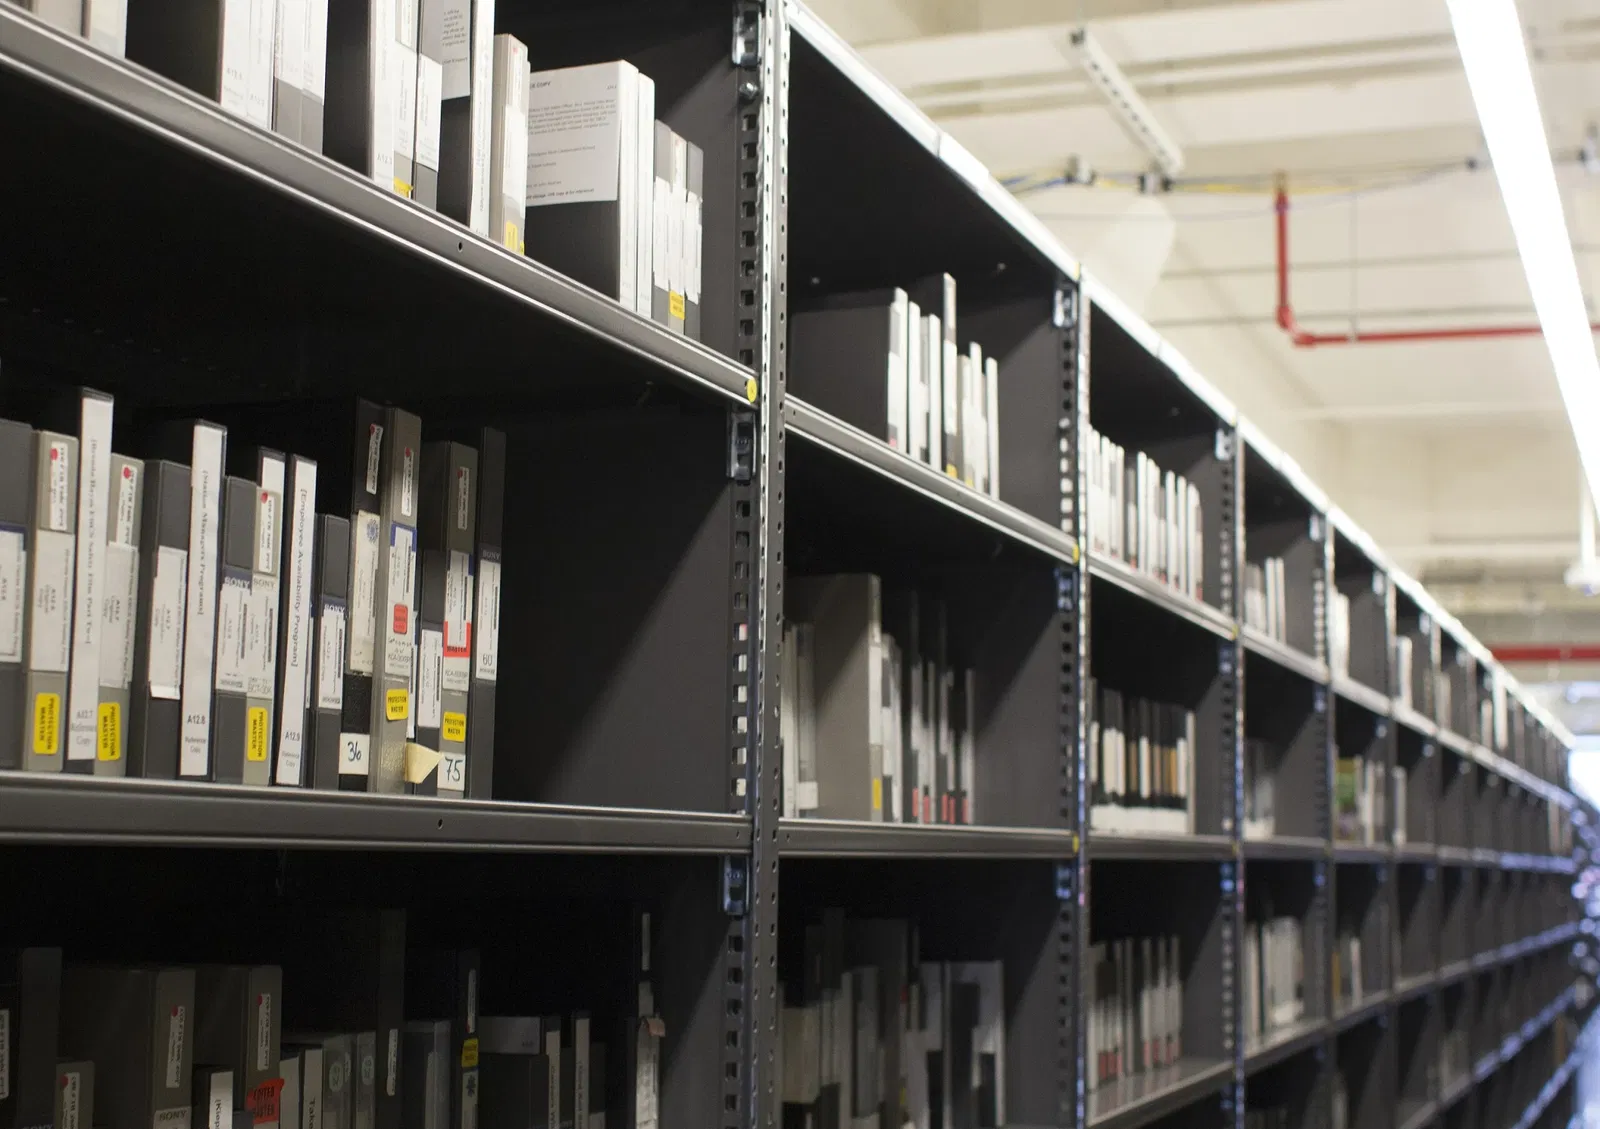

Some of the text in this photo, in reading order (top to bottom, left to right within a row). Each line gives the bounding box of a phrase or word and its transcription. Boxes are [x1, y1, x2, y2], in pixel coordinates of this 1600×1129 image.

[224, 577, 250, 589] SONY
[291, 489, 308, 667] [Employee Availability Program]
[324, 604, 345, 613] SONY
[482, 653, 493, 666] 60
[387, 696, 407, 704] PROTECTION
[391, 705, 404, 713] MASTER
[186, 714, 206, 725] A12.8
[444, 717, 465, 727] PROTECTION
[284, 731, 301, 742] A12.9
[447, 727, 461, 735] MASTER
[347, 740, 362, 762] 36
[444, 755, 463, 783] 75
[159, 1110, 188, 1121] SONY
